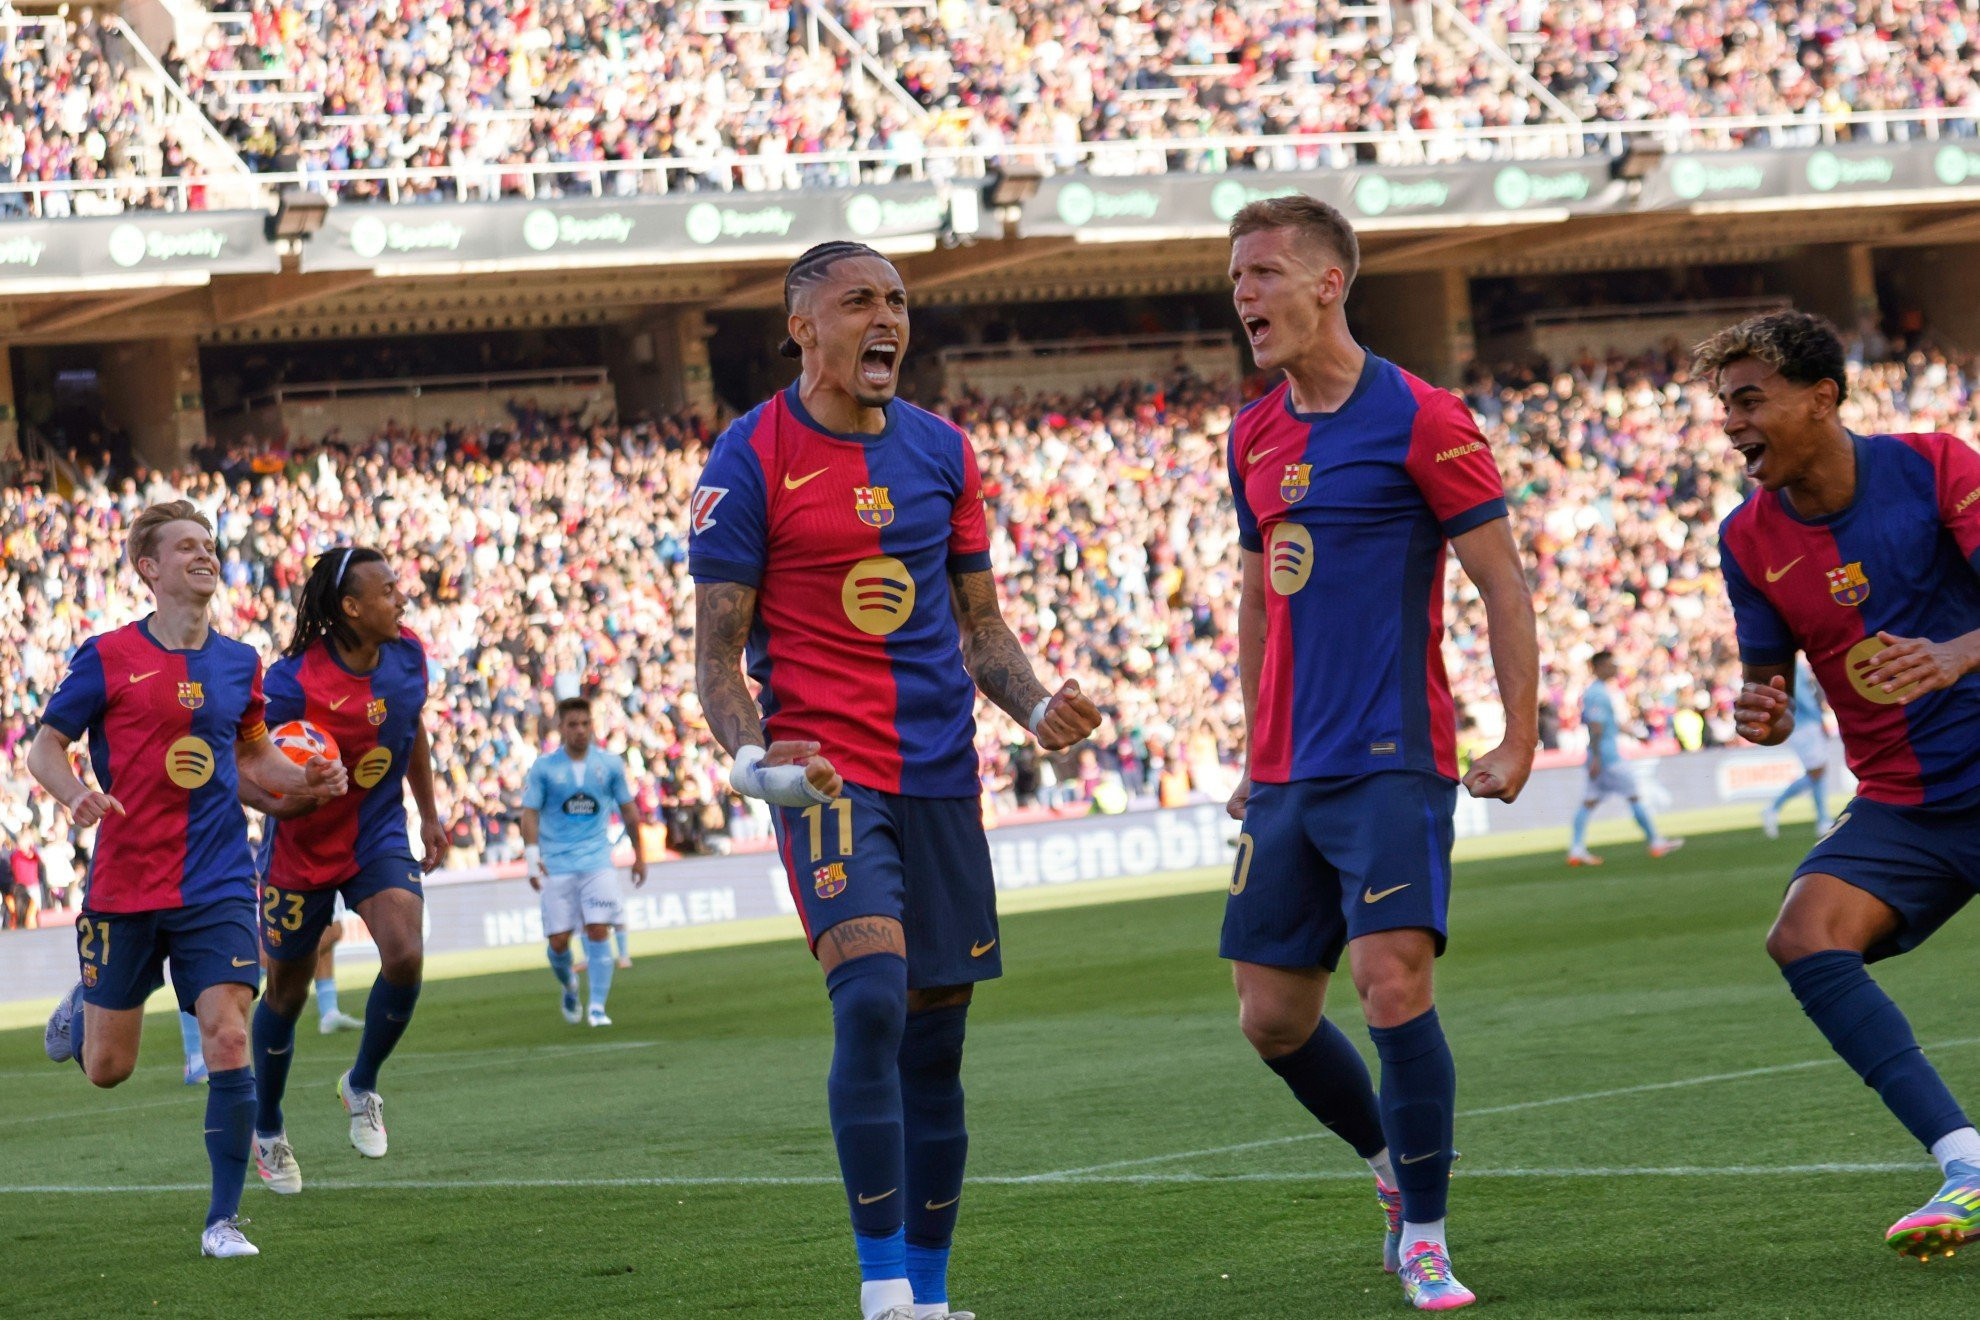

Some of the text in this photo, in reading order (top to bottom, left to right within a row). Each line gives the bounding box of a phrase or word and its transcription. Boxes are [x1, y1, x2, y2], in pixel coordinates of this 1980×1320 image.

[147, 228, 228, 260] Spotify
[387, 220, 465, 251] Spotify
[559, 213, 636, 244] Spotify
[722, 206, 796, 238] Spotify
[801, 798, 853, 863] 11
[988, 806, 1241, 889] uenobi
[264, 886, 305, 931] 23
[484, 907, 544, 947] INS
[627, 892, 689, 932] ELA
[689, 886, 736, 924] EN
[79, 917, 110, 966] 21
